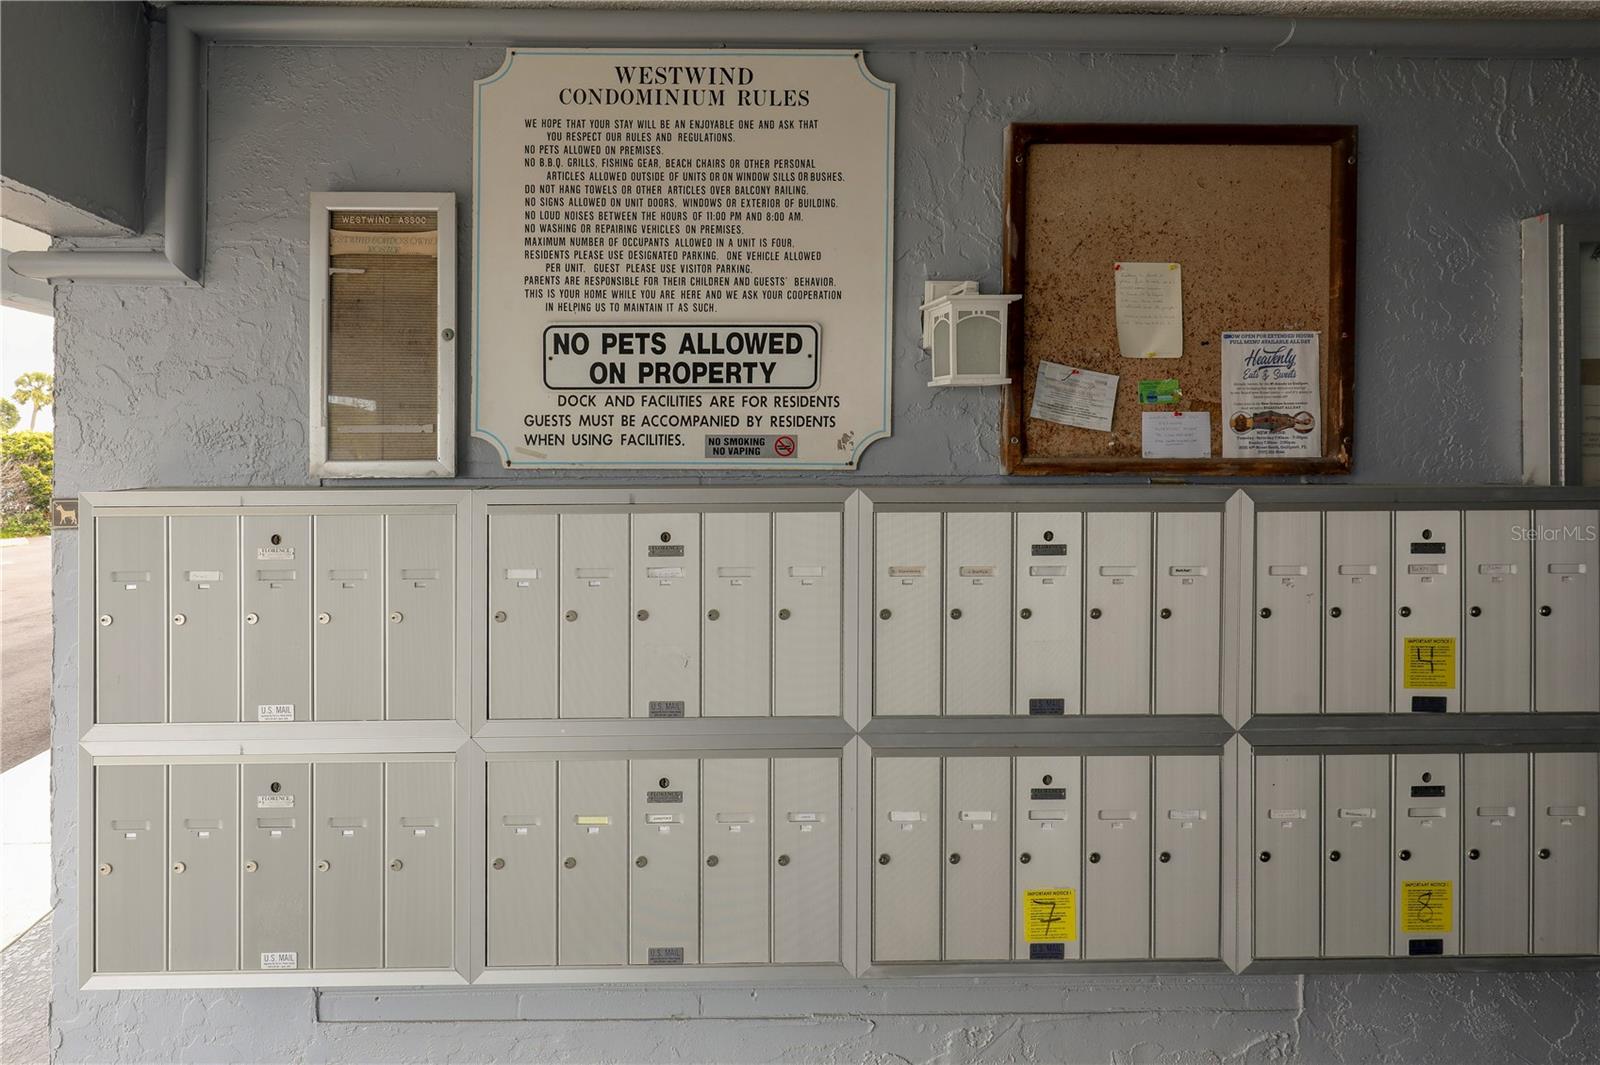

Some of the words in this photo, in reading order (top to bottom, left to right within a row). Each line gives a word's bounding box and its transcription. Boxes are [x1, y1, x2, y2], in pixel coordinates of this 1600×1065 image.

[615, 66, 753, 85] WESTWIND
[559, 88, 724, 106] CONDOMINIUM
[738, 90, 809, 107] RULES
[547, 131, 562, 141] YOU
[566, 131, 602, 142] RESPECT
[606, 132, 622, 142] OUR
[626, 132, 652, 142] RULES
[656, 132, 672, 142] AND
[678, 132, 735, 142] REGULATIONS.
[524, 144, 535, 154] NO
[539, 145, 559, 155] PETS
[563, 145, 601, 155] ALLOWED
[605, 145, 616, 155] ON
[620, 145, 663, 155] PREMISES.
[524, 157, 535, 167] NO
[539, 157, 563, 169] B.B.Q.
[602, 158, 633, 168] FISHING
[665, 158, 692, 168] BEACH
[696, 158, 726, 169] CHAIRS
[729, 159, 740, 169] OR
[744, 159, 770, 169] OTHER
[774, 159, 816, 169] PERSONAL
[525, 184, 535, 194] DO
[539, 184, 555, 194] NOT
[559, 184, 581, 194] HANG
[585, 185, 617, 195] TOWELS
[621, 185, 632, 195] OR
[636, 185, 662, 195] OTHER
[667, 185, 706, 195] ARTICLES
[710, 185, 731, 195] OVER
[735, 185, 771, 195] BALCONY
[774, 185, 808, 195] RAILING.
[525, 197, 536, 207] NO
[540, 197, 564, 207] SIGNS
[568, 197, 606, 207] ALLOWED
[610, 197, 621, 207] ON
[625, 198, 643, 207] UNIT
[682, 198, 722, 208] WINDOWS
[726, 198, 737, 208] OR
[741, 198, 780, 208] EXTERIOR
[784, 198, 794, 208] OF
[798, 198, 838, 208] BUILDING.
[342, 216, 390, 224] WESTWIND
[398, 216, 426, 224] ASSOC
[525, 223, 535, 233] NO
[539, 223, 577, 233] WASHING
[580, 223, 591, 233] OR
[595, 224, 637, 234] REPAIRING
[641, 224, 680, 234] VEHICLES
[685, 224, 696, 234] ON
[700, 224, 744, 235] PREMISES.
[524, 250, 570, 260] RESIDENTS
[574, 250, 604, 260] PLEASE
[608, 250, 624, 260] USE
[628, 250, 678, 260] DESIGNATED
[682, 250, 719, 260] PARKING.
[726, 251, 742, 261] ONE
[746, 251, 779, 261] VEHICLE
[784, 251, 821, 261] ALLOWED
[545, 263, 561, 272] PER
[565, 263, 585, 273] UNIT.
[594, 263, 620, 273] GUEST
[626, 263, 656, 273] PLEASE
[660, 264, 676, 274] USE
[680, 264, 712, 274] VISITOR
[716, 264, 752, 274] PARKING.
[524, 275, 560, 285] PARENTS
[564, 276, 580, 286] ARE
[584, 276, 639, 286] RESPONSIBLE
[643, 276, 659, 286] FOR
[663, 276, 686, 286] THEIR
[690, 276, 730, 286] CHILDREN
[733, 277, 750, 286] AND
[794, 277, 836, 287] BEHAVIOR.
[545, 302, 554, 311] IN
[558, 302, 591, 312] HELPING
[595, 302, 606, 312] US
[610, 302, 620, 312] TO
[623, 303, 663, 312] MAINTAIN
[666, 302, 674, 312] IT
[678, 302, 689, 312] AS
[693, 302, 717, 312] SUCH.
[553, 332, 589, 355] NO
[602, 332, 666, 355] PETS
[678, 332, 803, 355] ALLOWED
[1244, 346, 1297, 370] Heavenly
[589, 362, 625, 385] ON
[639, 361, 777, 384] PROPERTY
[1243, 368, 1259, 380] Eats
[1273, 369, 1297, 380] Sweets
[558, 394, 596, 407] DOCK
[604, 395, 635, 407] AND
[641, 395, 702, 407] FACILITIES
[709, 395, 735, 408] ARE
[742, 395, 768, 408] FOR
[774, 395, 840, 408] RESIDENTS
[524, 414, 571, 427] GUESTS
[579, 414, 614, 427] MUST
[621, 415, 635, 427] BE
[641, 415, 740, 427] ACCOMPANIED
[747, 415, 763, 427] BY
[770, 415, 836, 428] RESIDENTS
[524, 434, 565, 446] WHEN
[572, 433, 613, 446] USING
[621, 433, 685, 446] FACILITIES.
[708, 437, 721, 446] NO
[724, 437, 765, 446] SMOKING
[713, 447, 725, 455] NO
[728, 447, 761, 456] VAPING
[1417, 646, 1434, 673] 4
[1417, 892, 1434, 922] 8
[1033, 900, 1061, 936] 7
